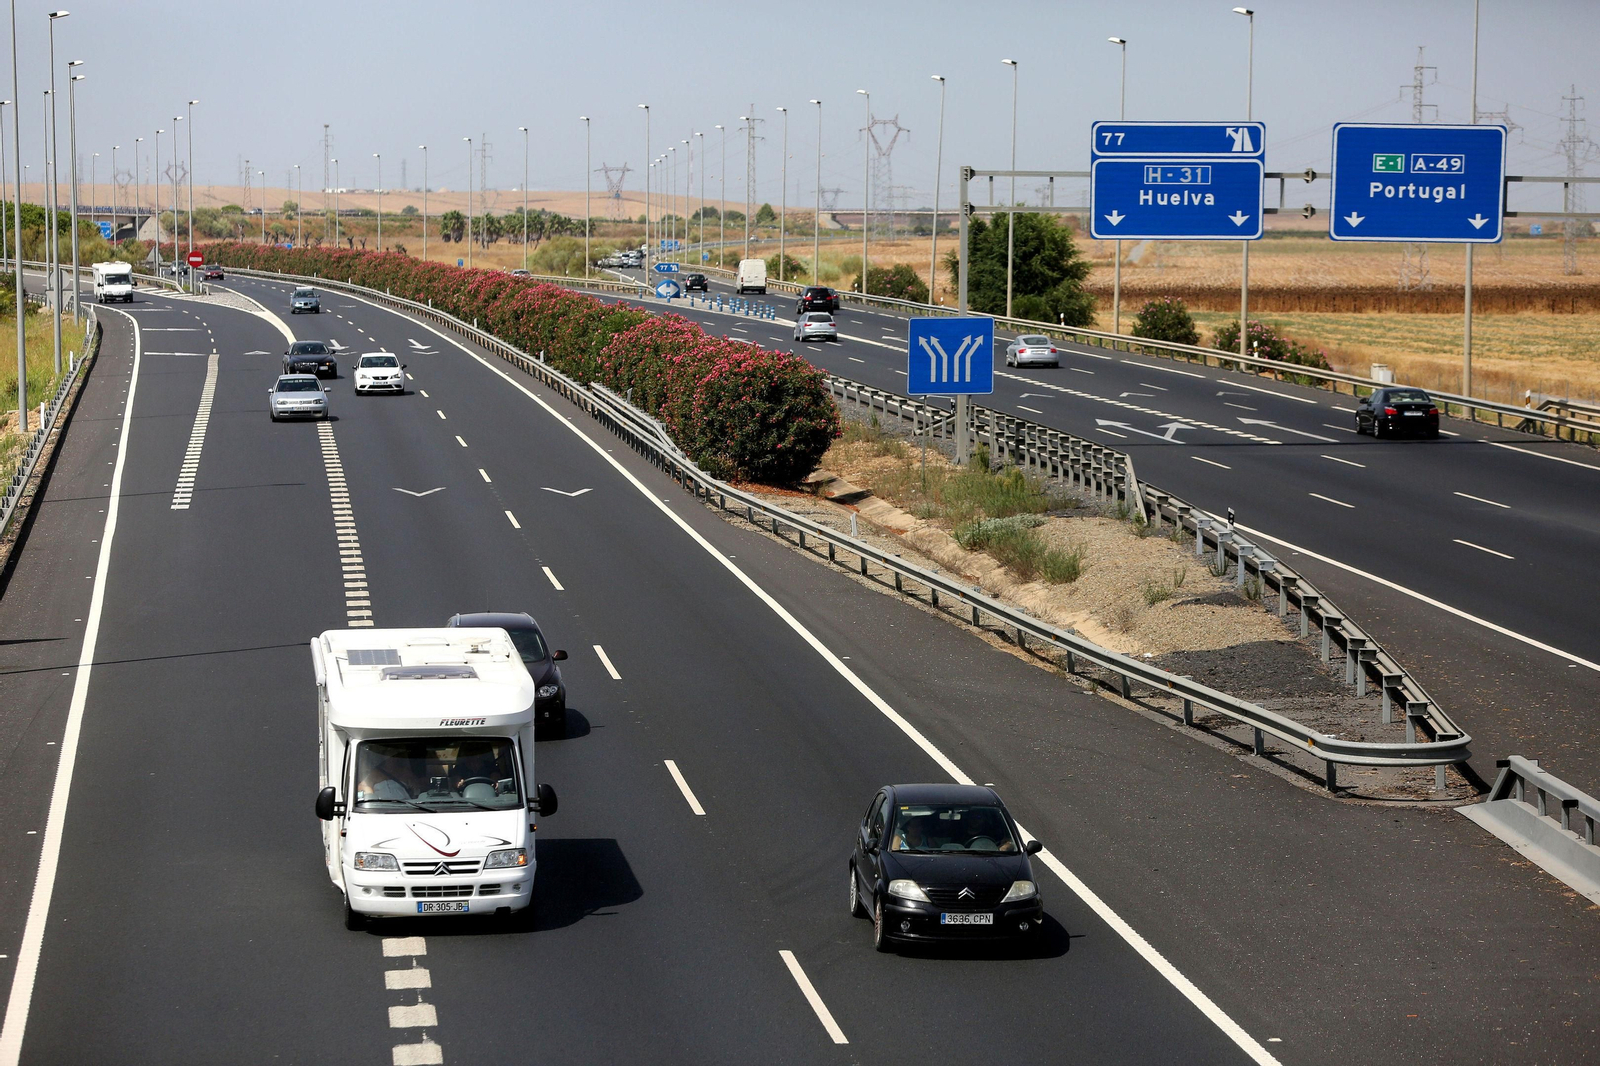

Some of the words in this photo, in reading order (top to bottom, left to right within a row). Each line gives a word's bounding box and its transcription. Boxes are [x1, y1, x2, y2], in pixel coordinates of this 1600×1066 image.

[1102, 133, 1125, 146] 77
[1375, 157, 1402, 170] E-1
[1414, 158, 1462, 171] A-49
[1139, 190, 1215, 205] Huelva
[1369, 182, 1466, 203] Portugal
[439, 717, 487, 727] FLEURETTE
[973, 914, 991, 923] CPN
